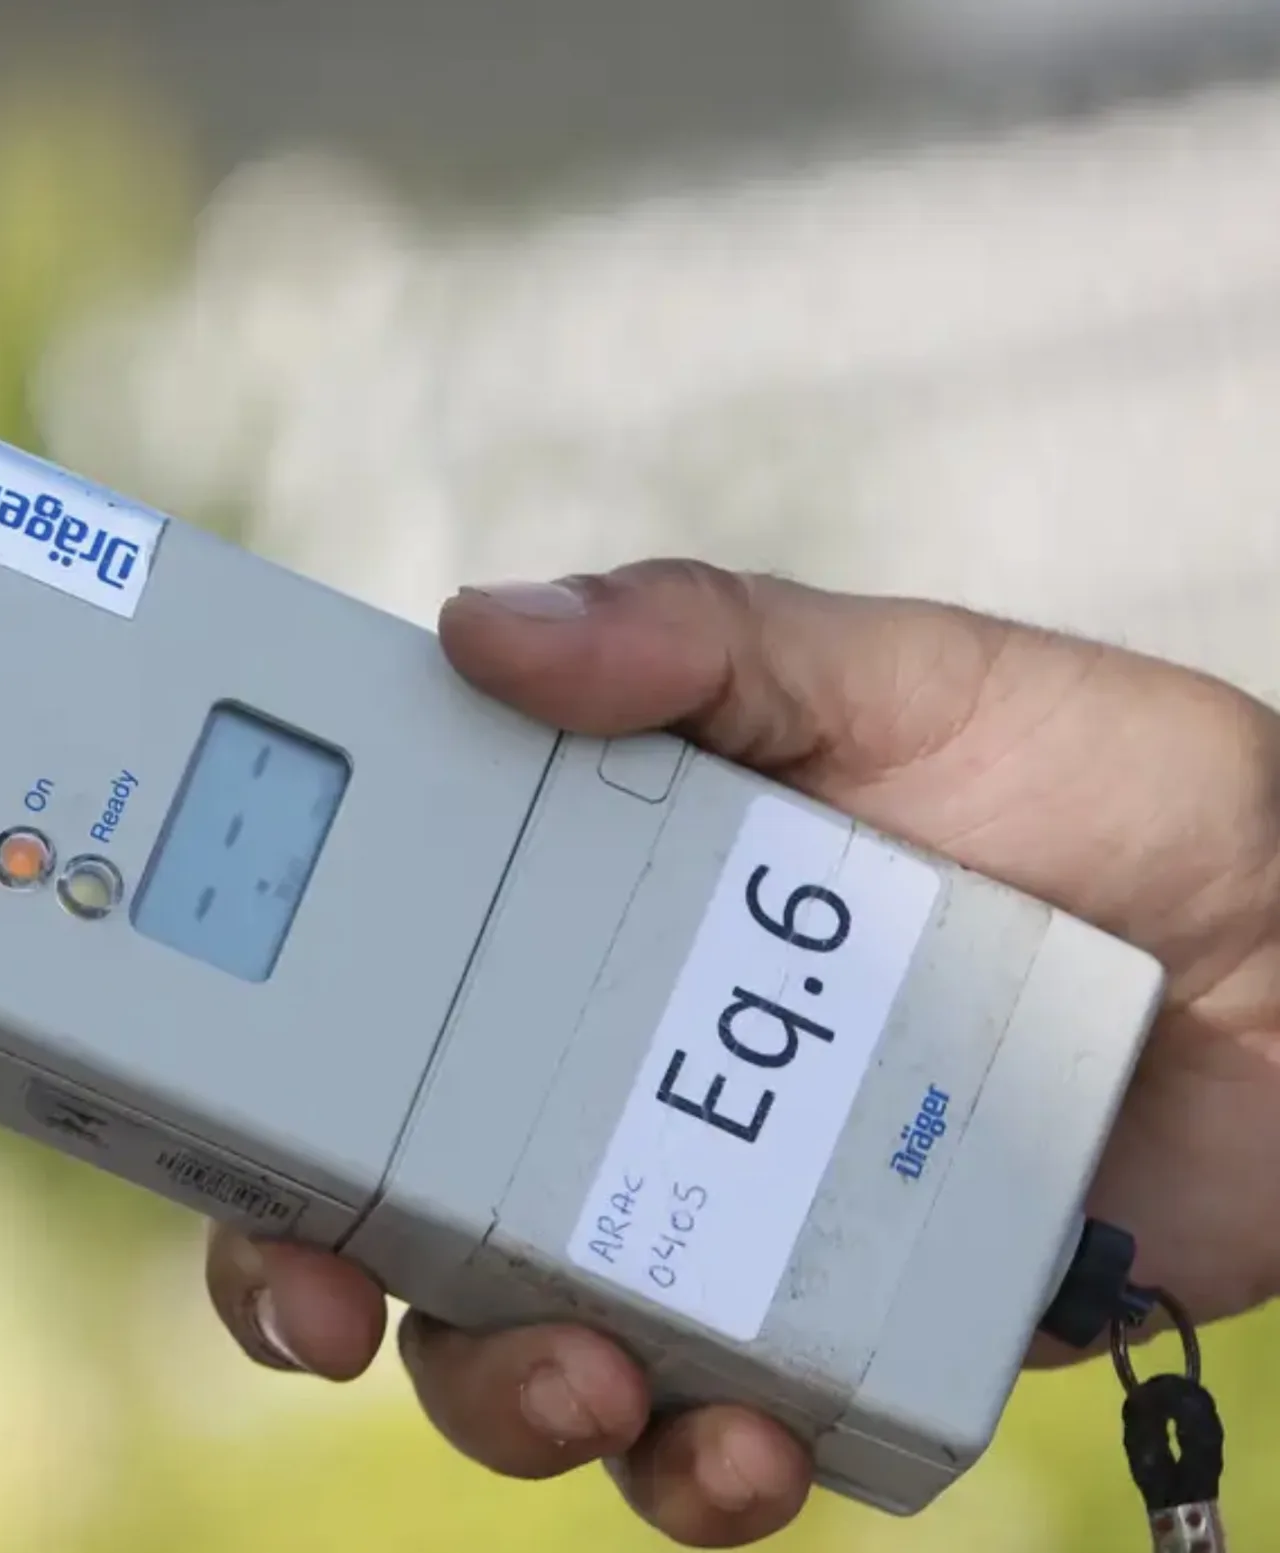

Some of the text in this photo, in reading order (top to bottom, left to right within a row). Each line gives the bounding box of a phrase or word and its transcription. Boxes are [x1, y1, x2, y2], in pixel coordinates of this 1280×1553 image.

[24, 777, 56, 812] On
[90, 769, 140, 844] Ready
[656, 864, 852, 1144] Eq.6
[890, 1083, 951, 1179] Dräger
[588, 1174, 645, 1264] ARAC
[649, 1182, 707, 1288] 0405
